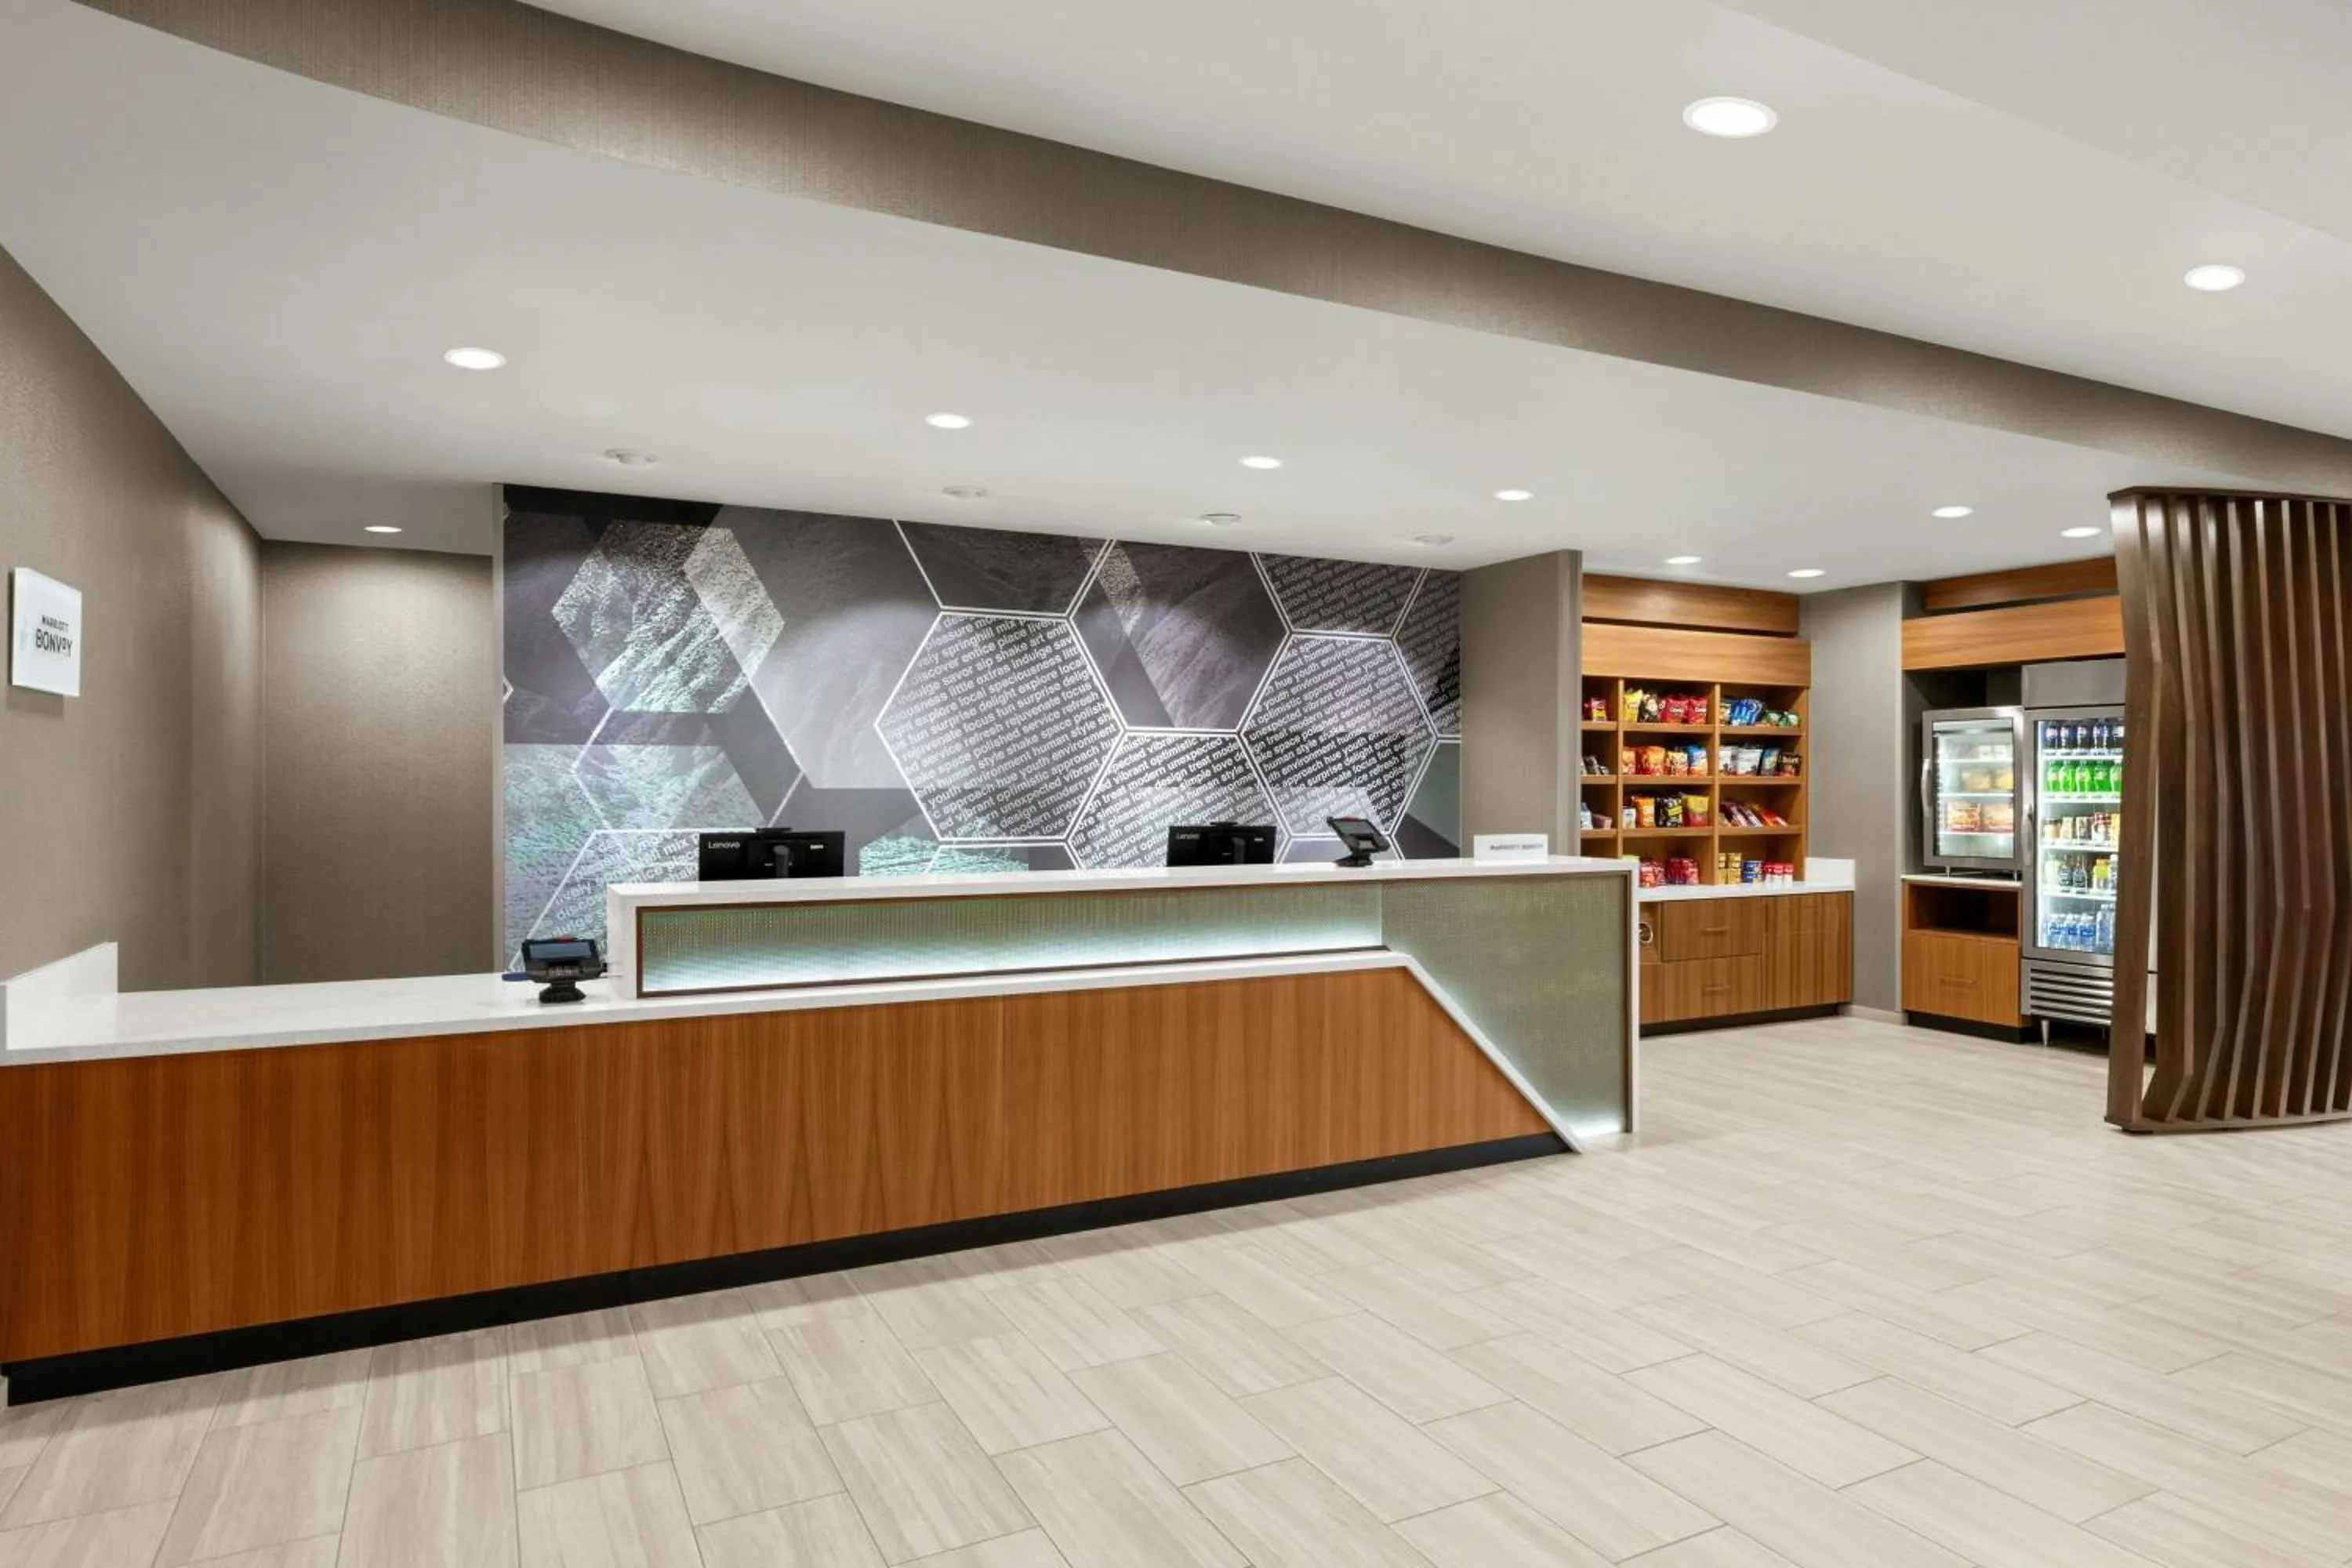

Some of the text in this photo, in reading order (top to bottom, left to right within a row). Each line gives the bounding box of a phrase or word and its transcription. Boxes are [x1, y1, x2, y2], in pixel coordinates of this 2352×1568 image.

[36, 628, 72, 658] BONVOY
[994, 641, 1028, 662] shake
[1029, 632, 1045, 647] art
[996, 628, 1027, 650] place
[948, 679, 975, 697] little
[975, 663, 1010, 685] extras
[1009, 644, 1052, 669] indulge
[957, 686, 987, 707] local
[988, 654, 1062, 695] spaciousness
[1257, 651, 1387, 724] optimistic approach hue youth
[1263, 647, 1375, 710] youth environment human
[1273, 660, 1320, 689] hue youth
[930, 706, 978, 735] surprise
[977, 686, 1017, 713] delight
[1018, 670, 1058, 694] explore
[962, 713, 996, 733] focus
[1016, 681, 1062, 709] surprise
[964, 720, 1004, 747] refresh
[1004, 695, 1062, 728] rejuvenate
[1060, 681, 1092, 701] focus
[972, 727, 1022, 760] polished
[1022, 710, 1061, 734] service
[1062, 689, 1099, 715] refresh
[1248, 708, 1302, 740] unexpected
[1301, 691, 1334, 713] vibrant
[1265, 727, 1288, 744] treat
[1287, 710, 1323, 732] modern
[963, 749, 1032, 790] environment
[1031, 733, 1069, 757] human
[1069, 720, 1098, 739] style
[977, 750, 1006, 769] style
[1005, 734, 1039, 756] shake
[1040, 718, 1073, 739] space
[1262, 751, 1295, 771] human
[1294, 739, 1318, 755] style
[1318, 725, 1345, 742] shake
[1272, 735, 1301, 753] space
[1301, 713, 1340, 741] polished
[1280, 740, 1337, 774] environment
[1335, 725, 1367, 745] human
[942, 721, 1116, 815] approach hue youth environment
[995, 771, 1050, 802] optimistic
[1050, 742, 1101, 775] approach
[1112, 736, 1198, 784] vibrant optimistic
[1127, 766, 1167, 790] modern
[1166, 735, 1222, 770] unexpected
[1152, 768, 1188, 789] design
[1187, 753, 1212, 771] treat
[1178, 768, 1212, 789] simple
[1210, 757, 1233, 772] love
[1280, 759, 1324, 786] approach
[1323, 750, 1342, 764] hue
[1341, 735, 1367, 757] youth
[1306, 763, 1344, 786] surprise
[1341, 744, 1374, 766] delight
[1351, 757, 1377, 773] focus
[1376, 748, 1393, 760] fun
[1000, 775, 1062, 814] unexpected
[1062, 757, 1099, 782] vibrant
[1092, 826, 1123, 851] youth
[1184, 778, 1220, 800] human
[1219, 764, 1245, 782] style
[1233, 785, 1254, 799] hue
[997, 804, 1038, 829] design
[1009, 811, 1051, 837] modern
[1105, 797, 1203, 855] approach hue youth
[708, 840, 741, 850] Lenovo
